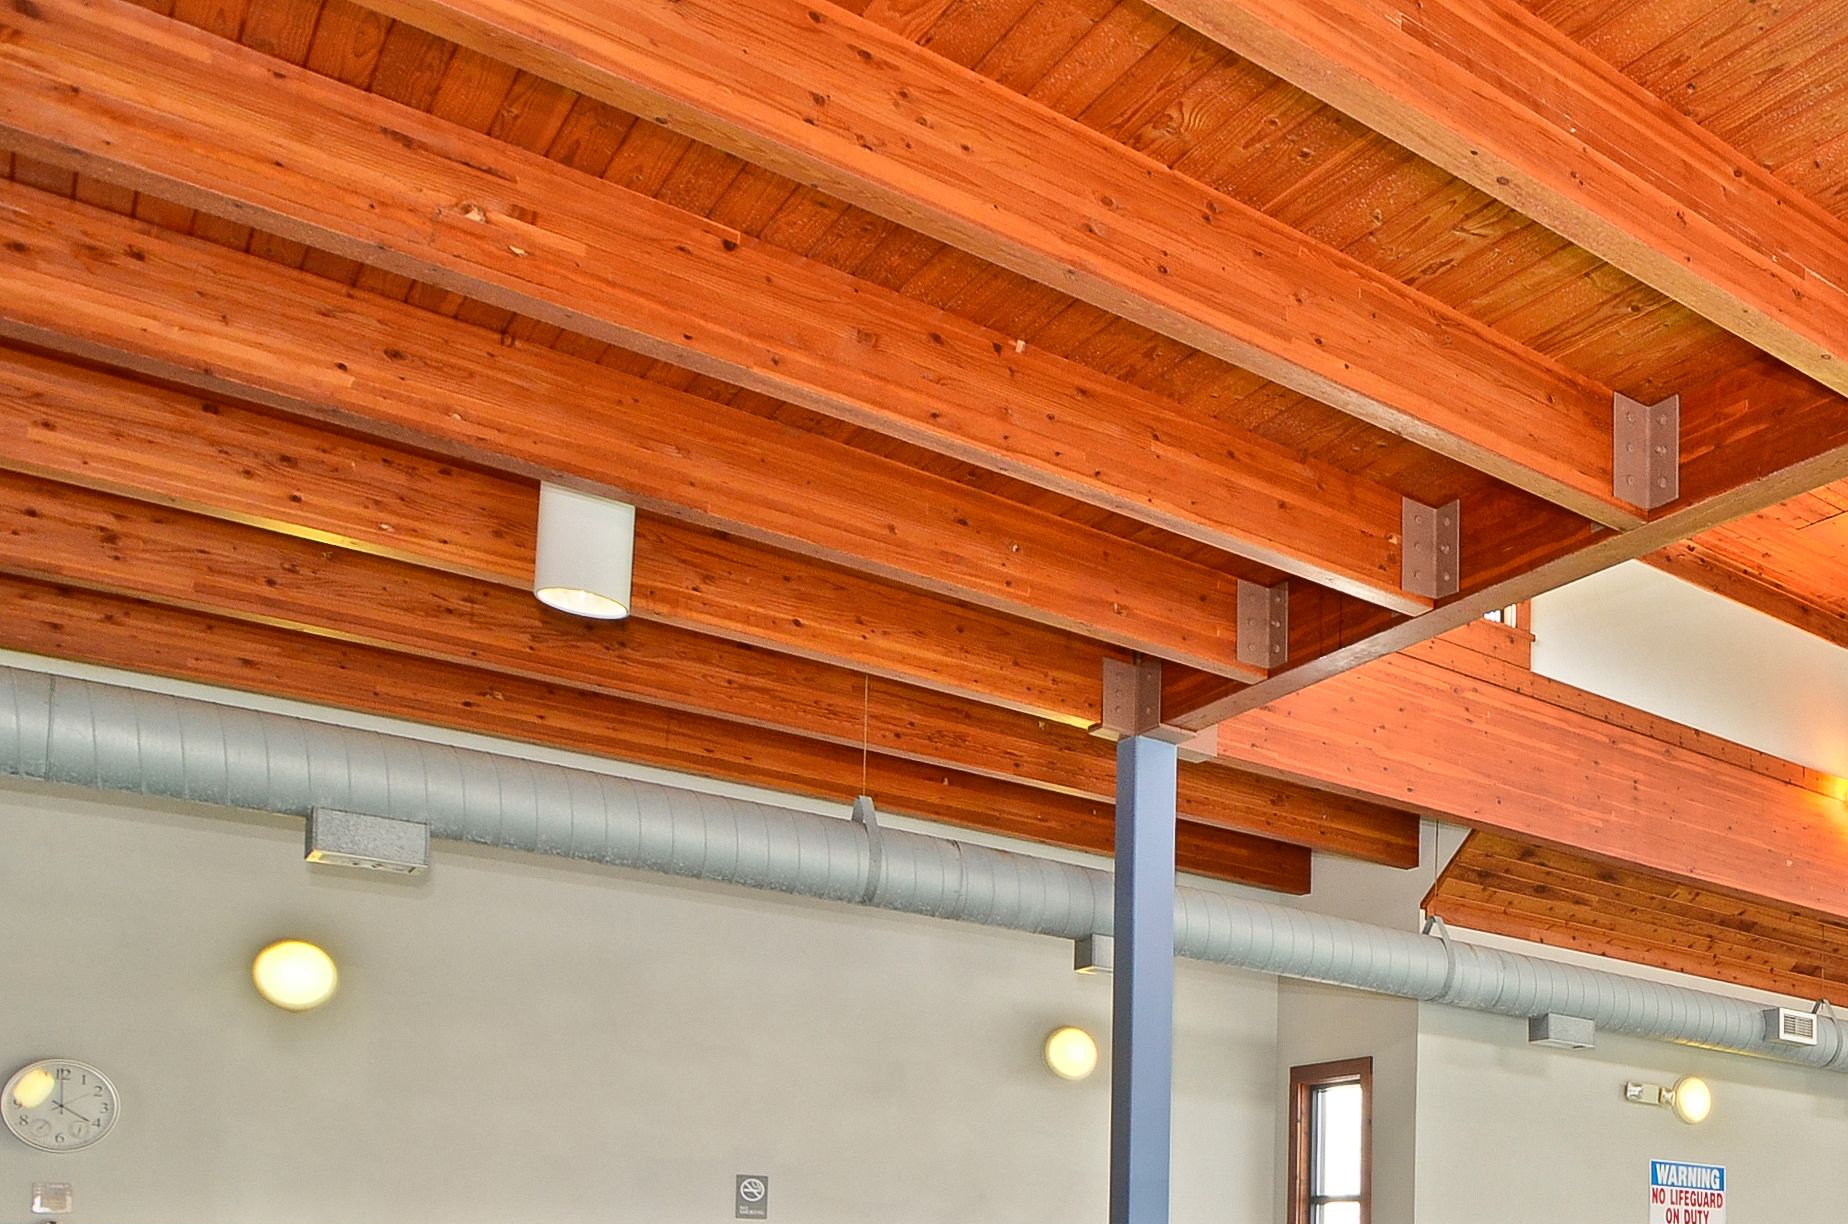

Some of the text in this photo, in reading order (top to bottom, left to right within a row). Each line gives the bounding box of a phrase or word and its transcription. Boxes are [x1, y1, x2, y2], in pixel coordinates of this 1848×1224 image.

[56, 1068, 71, 1081] 12
[93, 1086, 103, 1097] 2
[100, 1102, 109, 1114] 3
[18, 1114, 29, 1126] 8
[92, 1117, 101, 1128] 4
[55, 1131, 65, 1143] 6
[1656, 1163, 1720, 1189] WARNING
[1652, 1188, 1723, 1208] NO LIFEGUARD
[1666, 1208, 1680, 1224] ON
